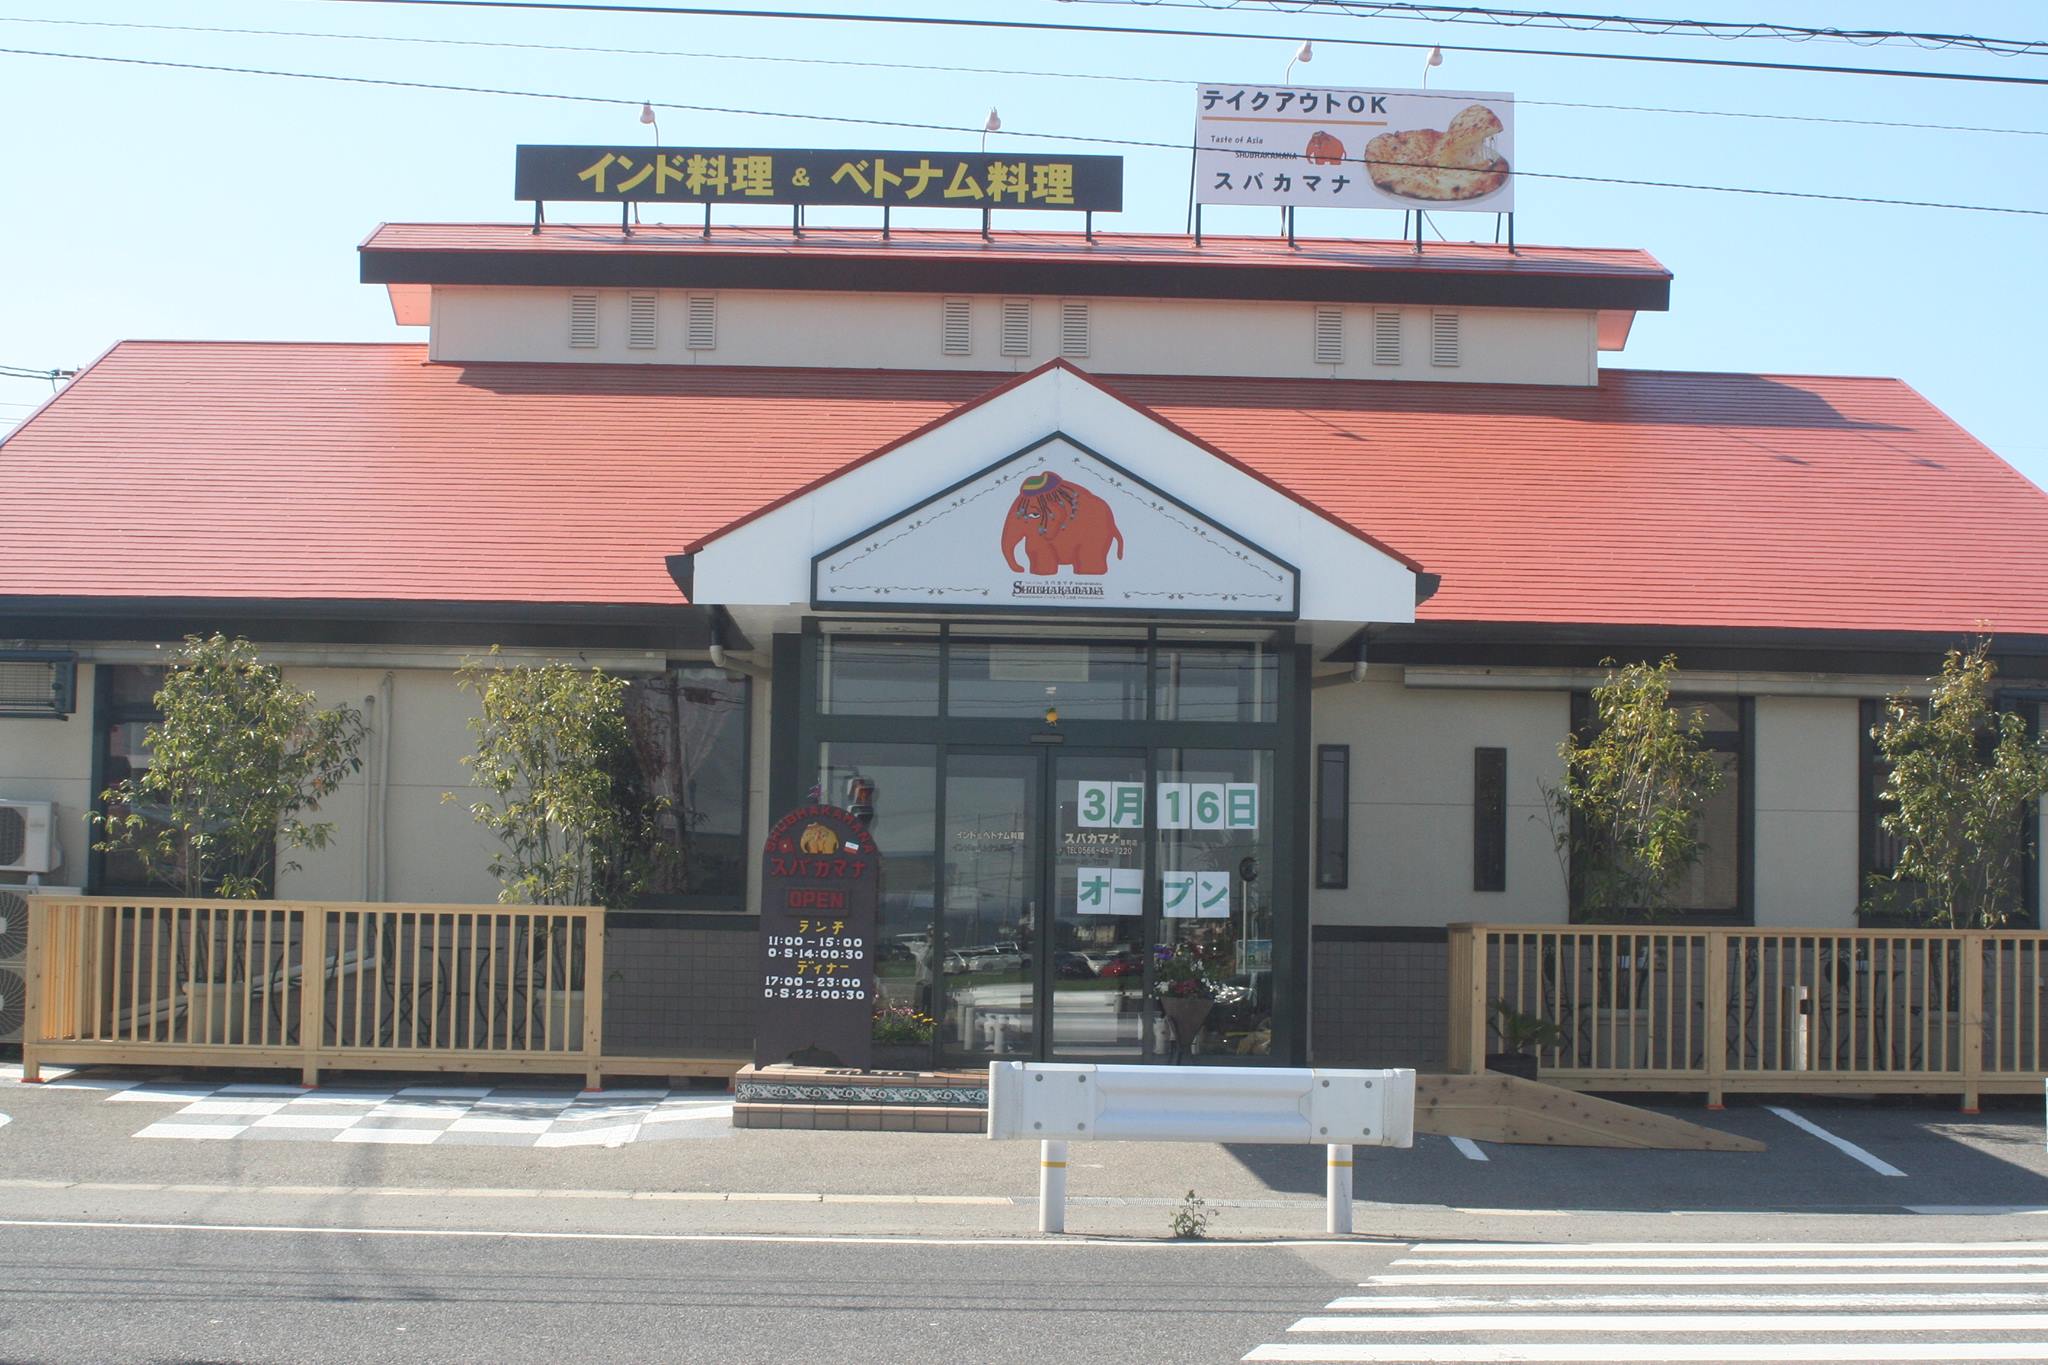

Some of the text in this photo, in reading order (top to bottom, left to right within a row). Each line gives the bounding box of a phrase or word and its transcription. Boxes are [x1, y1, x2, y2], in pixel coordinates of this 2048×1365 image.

[1203, 90, 1387, 114] テイクアウトOK
[1211, 135, 1264, 145] Taste of Asia
[577, 152, 1075, 204] インド料理 & ベトナム料理
[1214, 172, 1350, 194] スバカマナ
[789, 890, 845, 908] OPEN
[799, 920, 844, 935] ランチ
[797, 960, 849, 975] ディナー
